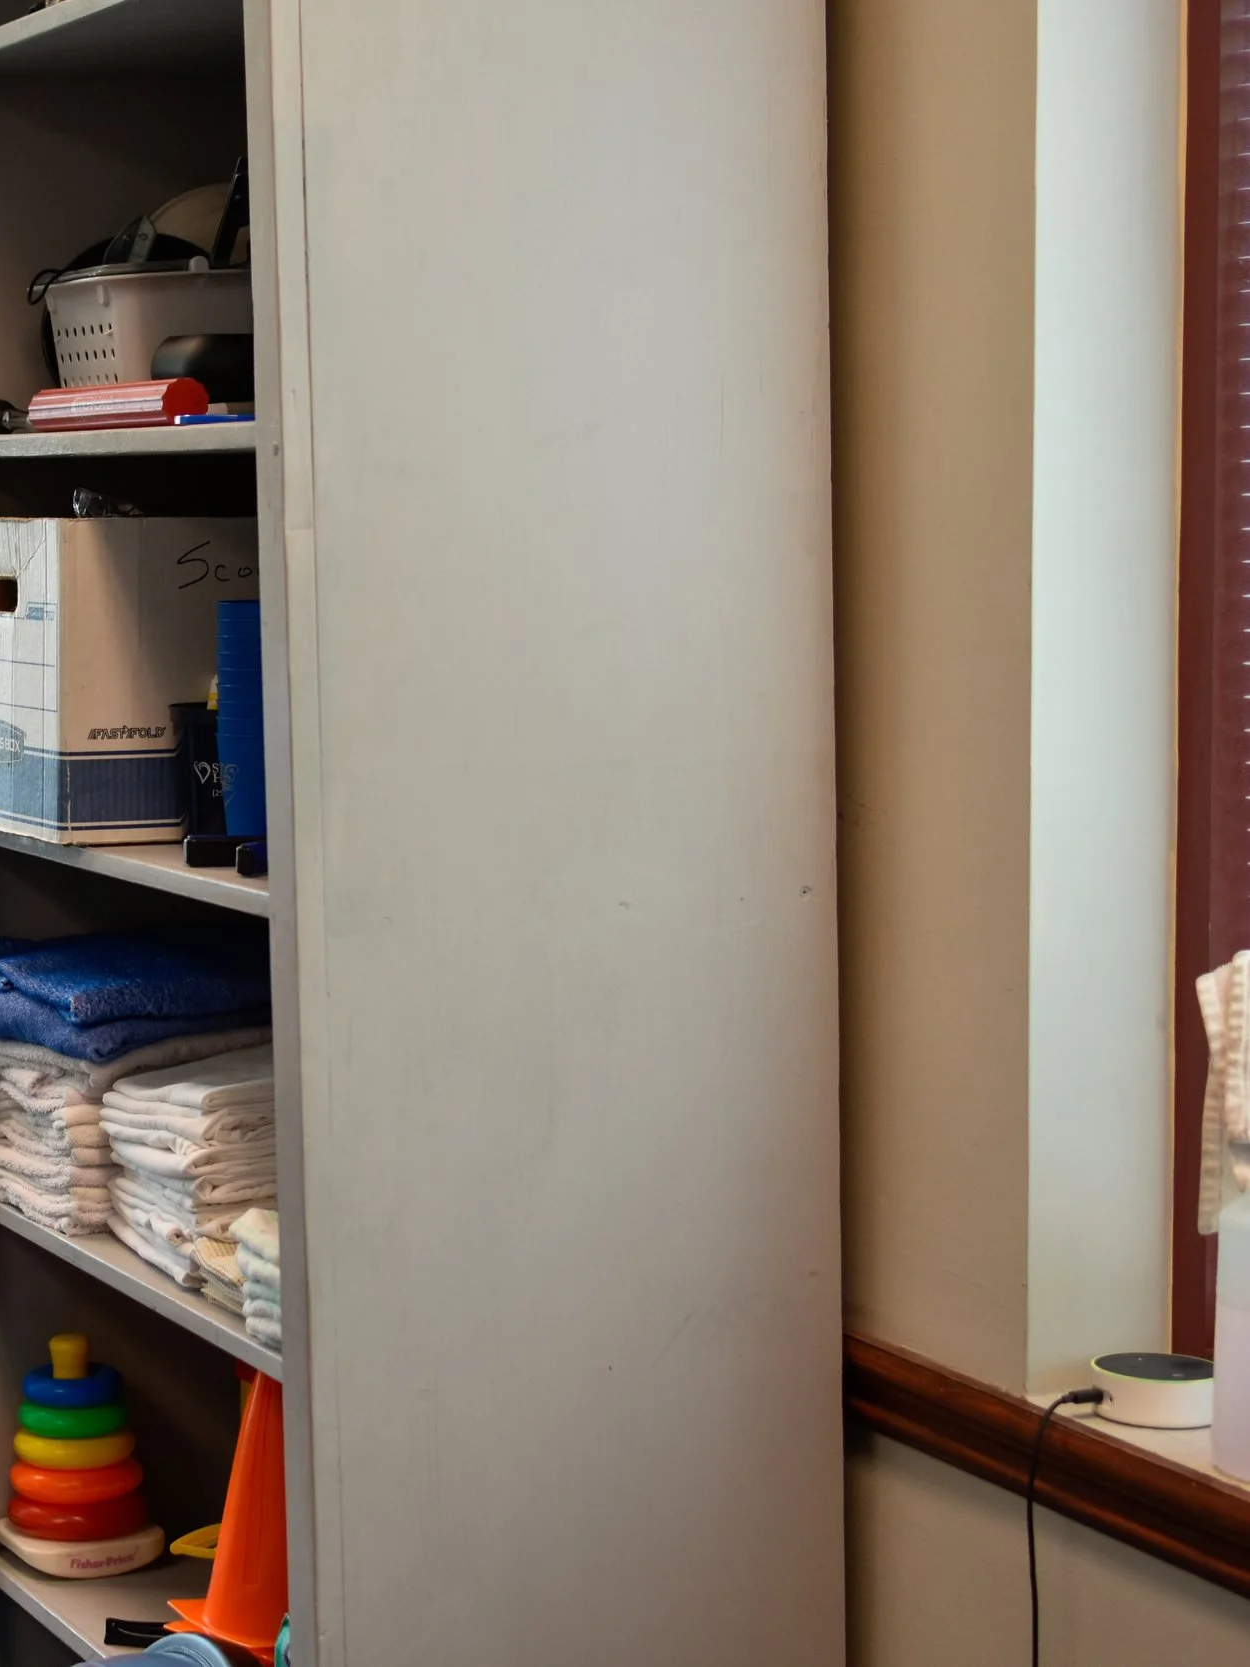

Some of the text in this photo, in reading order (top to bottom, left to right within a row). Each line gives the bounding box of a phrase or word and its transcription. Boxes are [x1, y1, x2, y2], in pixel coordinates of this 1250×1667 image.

[176, 540, 259, 590] Sco
[5, 737, 21, 753] BOX
[70, 1553, 136, 1569] Fisher-Price
